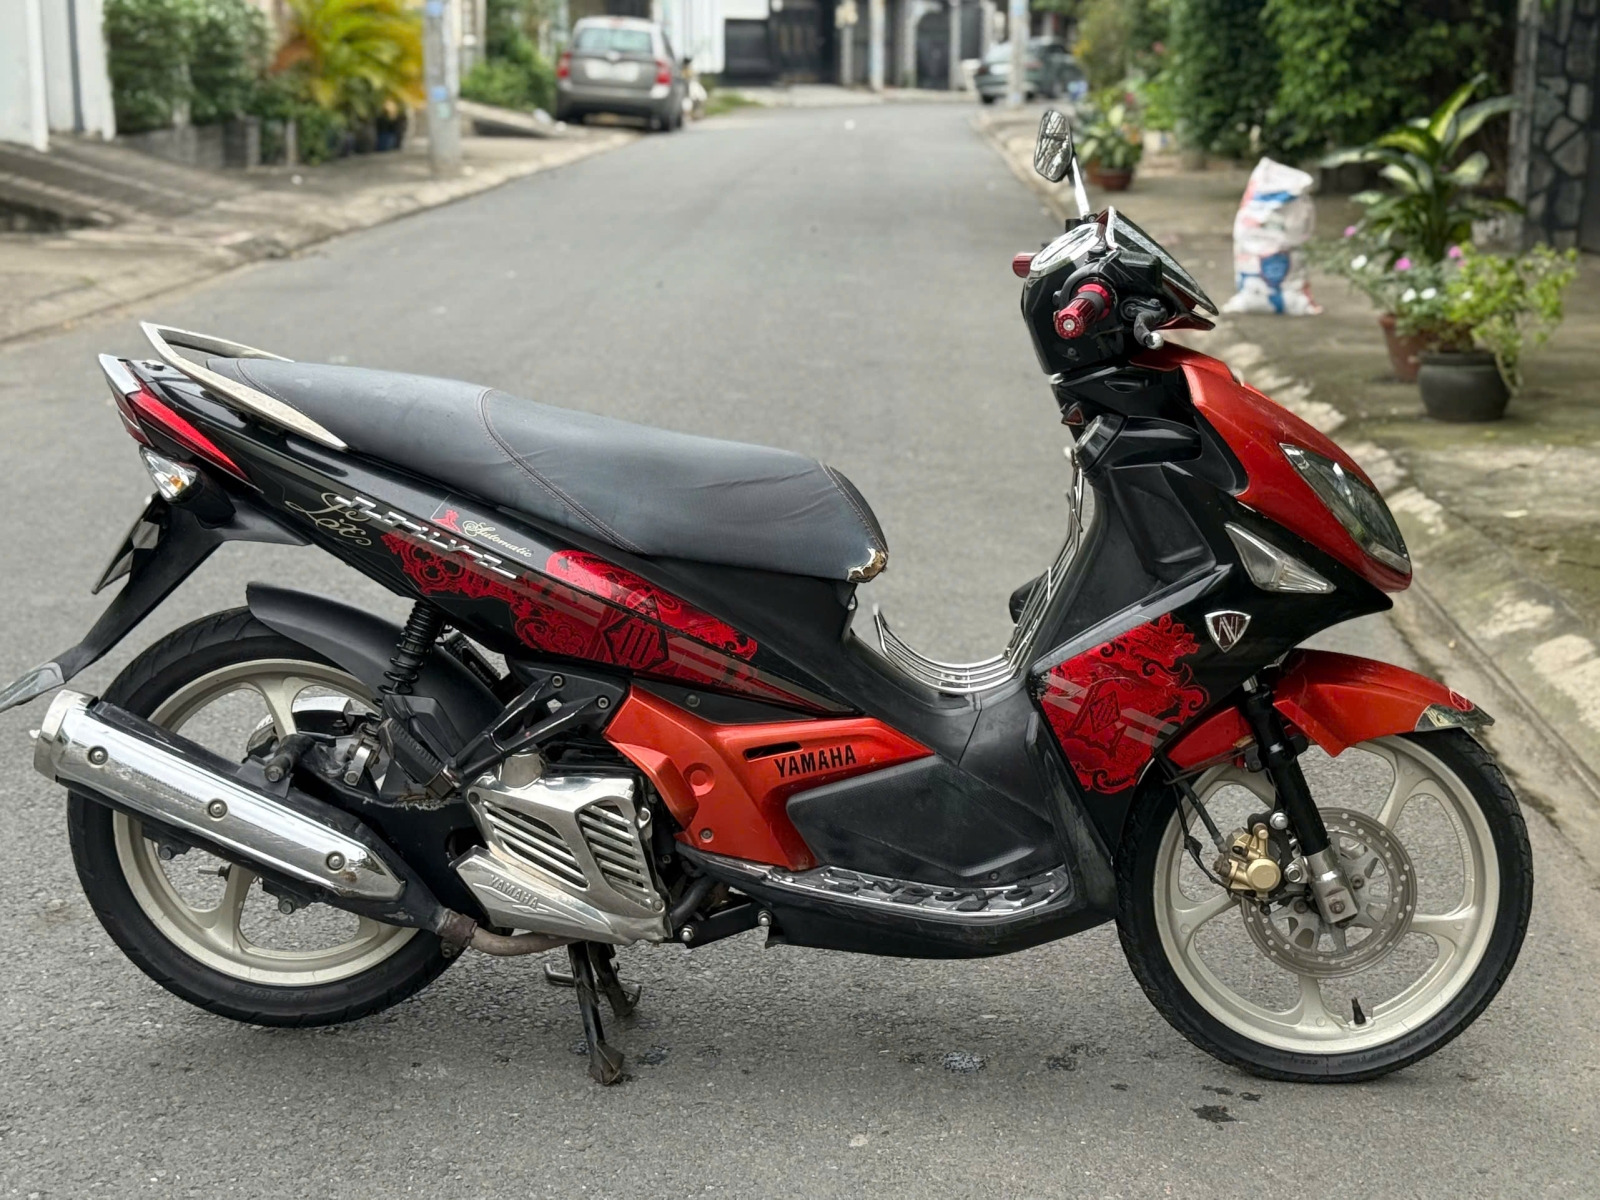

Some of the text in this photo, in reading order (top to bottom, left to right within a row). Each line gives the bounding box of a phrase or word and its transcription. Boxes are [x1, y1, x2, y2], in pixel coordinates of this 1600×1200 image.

[462, 520, 533, 558] Automatic
[773, 744, 857, 778] YAMAHA
[490, 874, 540, 908] YAMAHA
